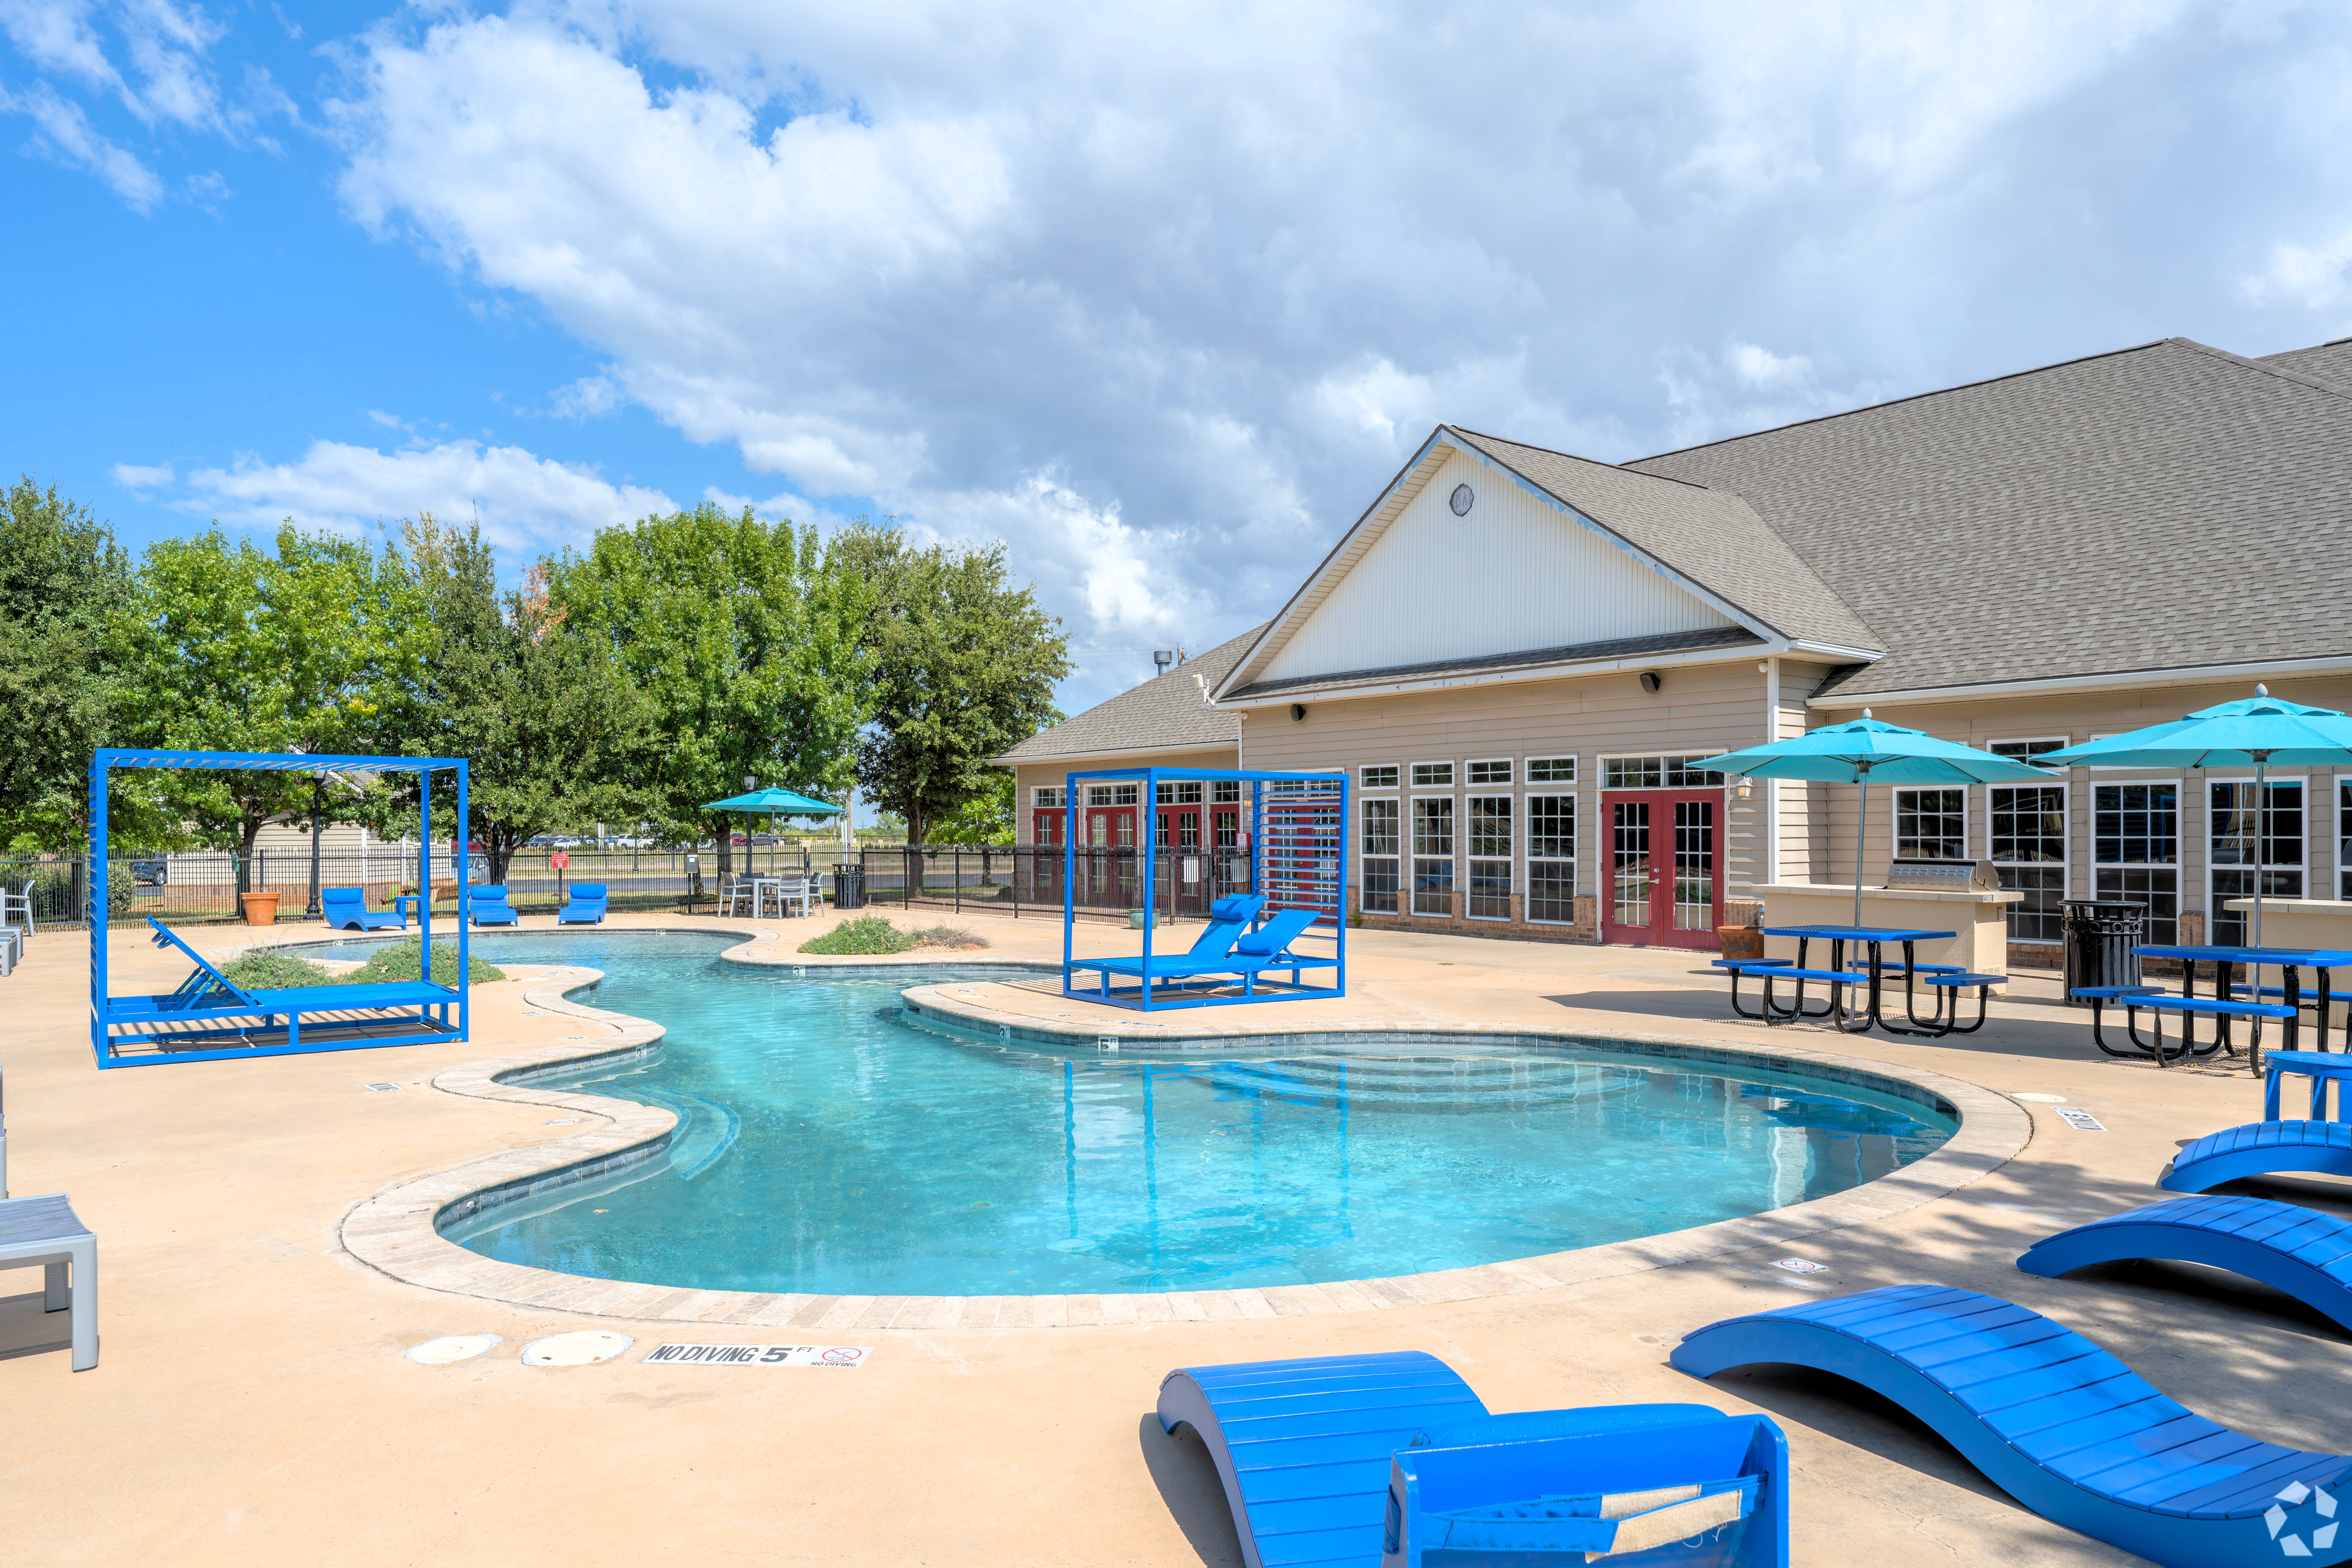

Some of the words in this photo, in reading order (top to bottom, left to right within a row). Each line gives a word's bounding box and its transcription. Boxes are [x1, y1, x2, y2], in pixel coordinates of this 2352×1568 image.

[1100, 1038, 1109, 1048] 5
[648, 1345, 685, 1360] NO
[678, 1346, 759, 1362] DIVING
[760, 1347, 794, 1362] 5
